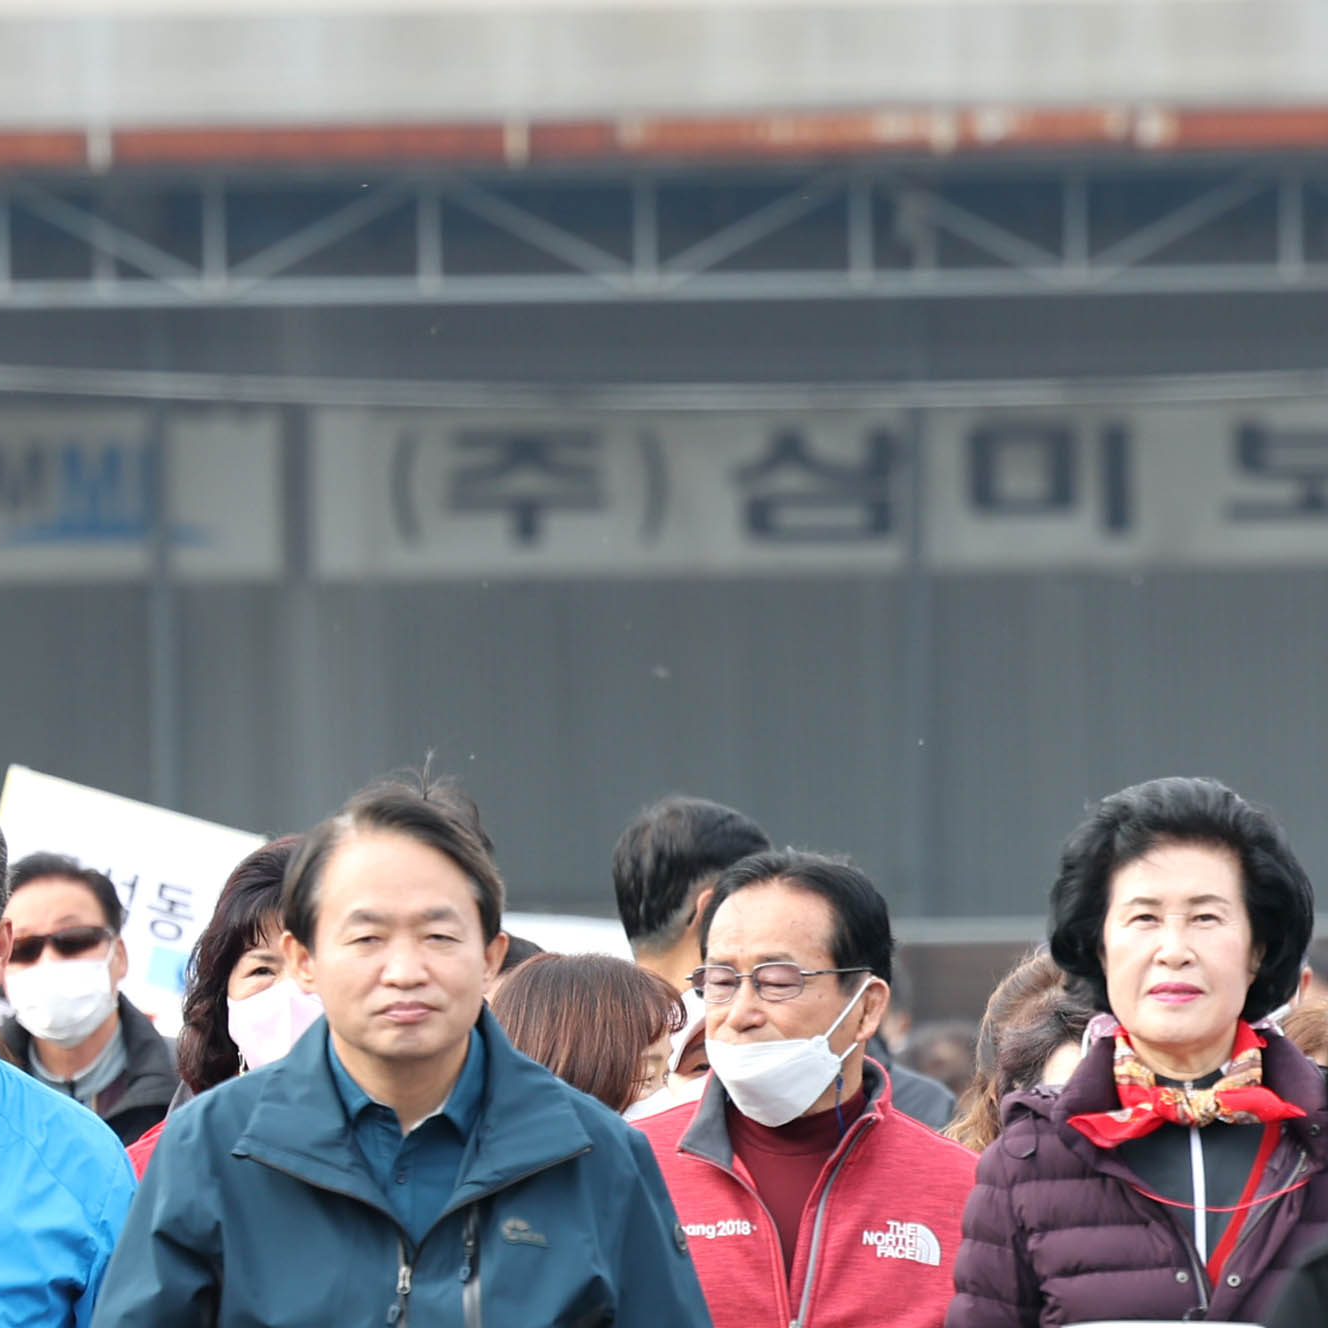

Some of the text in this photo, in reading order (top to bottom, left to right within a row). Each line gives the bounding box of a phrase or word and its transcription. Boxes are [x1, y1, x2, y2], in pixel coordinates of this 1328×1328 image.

[886, 1220, 918, 1235] THE
[862, 1231, 918, 1248] NORTH
[876, 1246, 918, 1260] FACE
